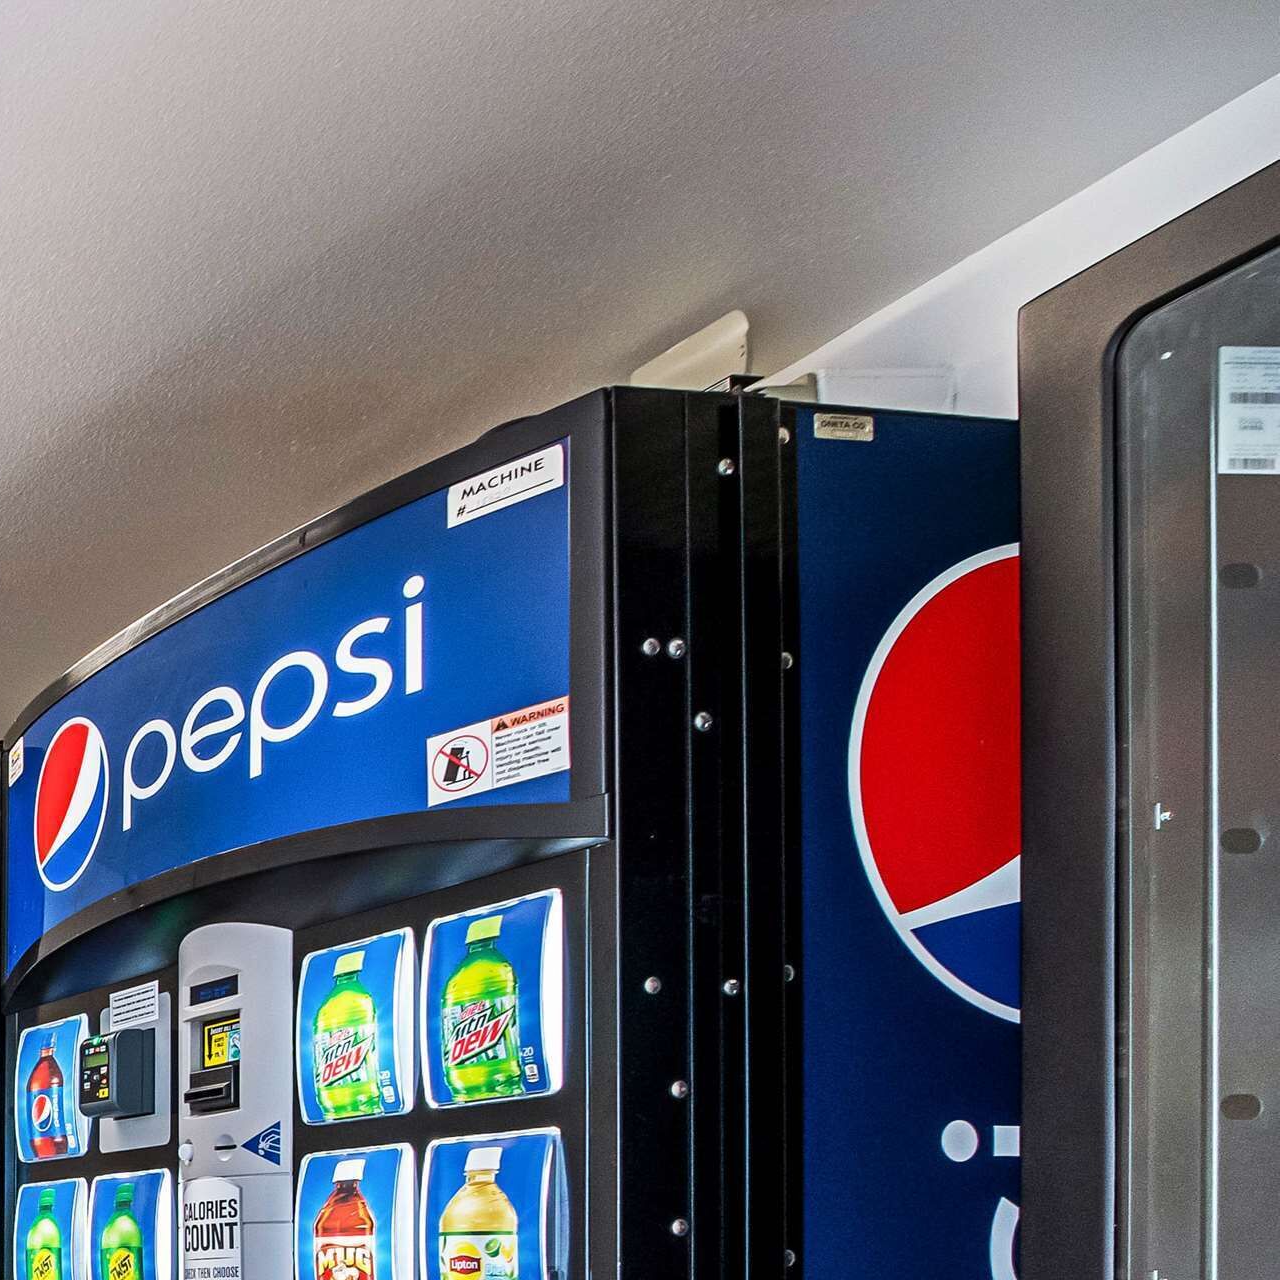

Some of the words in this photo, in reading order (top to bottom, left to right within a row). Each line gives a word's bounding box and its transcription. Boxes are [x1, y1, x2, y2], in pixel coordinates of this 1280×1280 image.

[461, 457, 544, 500] MACHINE
[456, 505, 466, 518] #
[123, 575, 425, 832] pepsi
[510, 703, 564, 727] WARNING
[184, 1199, 238, 1222] CALORIES
[185, 1222, 238, 1252] COUNT
[213, 1266, 239, 1278] CHOOSE
[318, 1247, 372, 1276] MUG
[451, 1260, 478, 1271] Lipton
